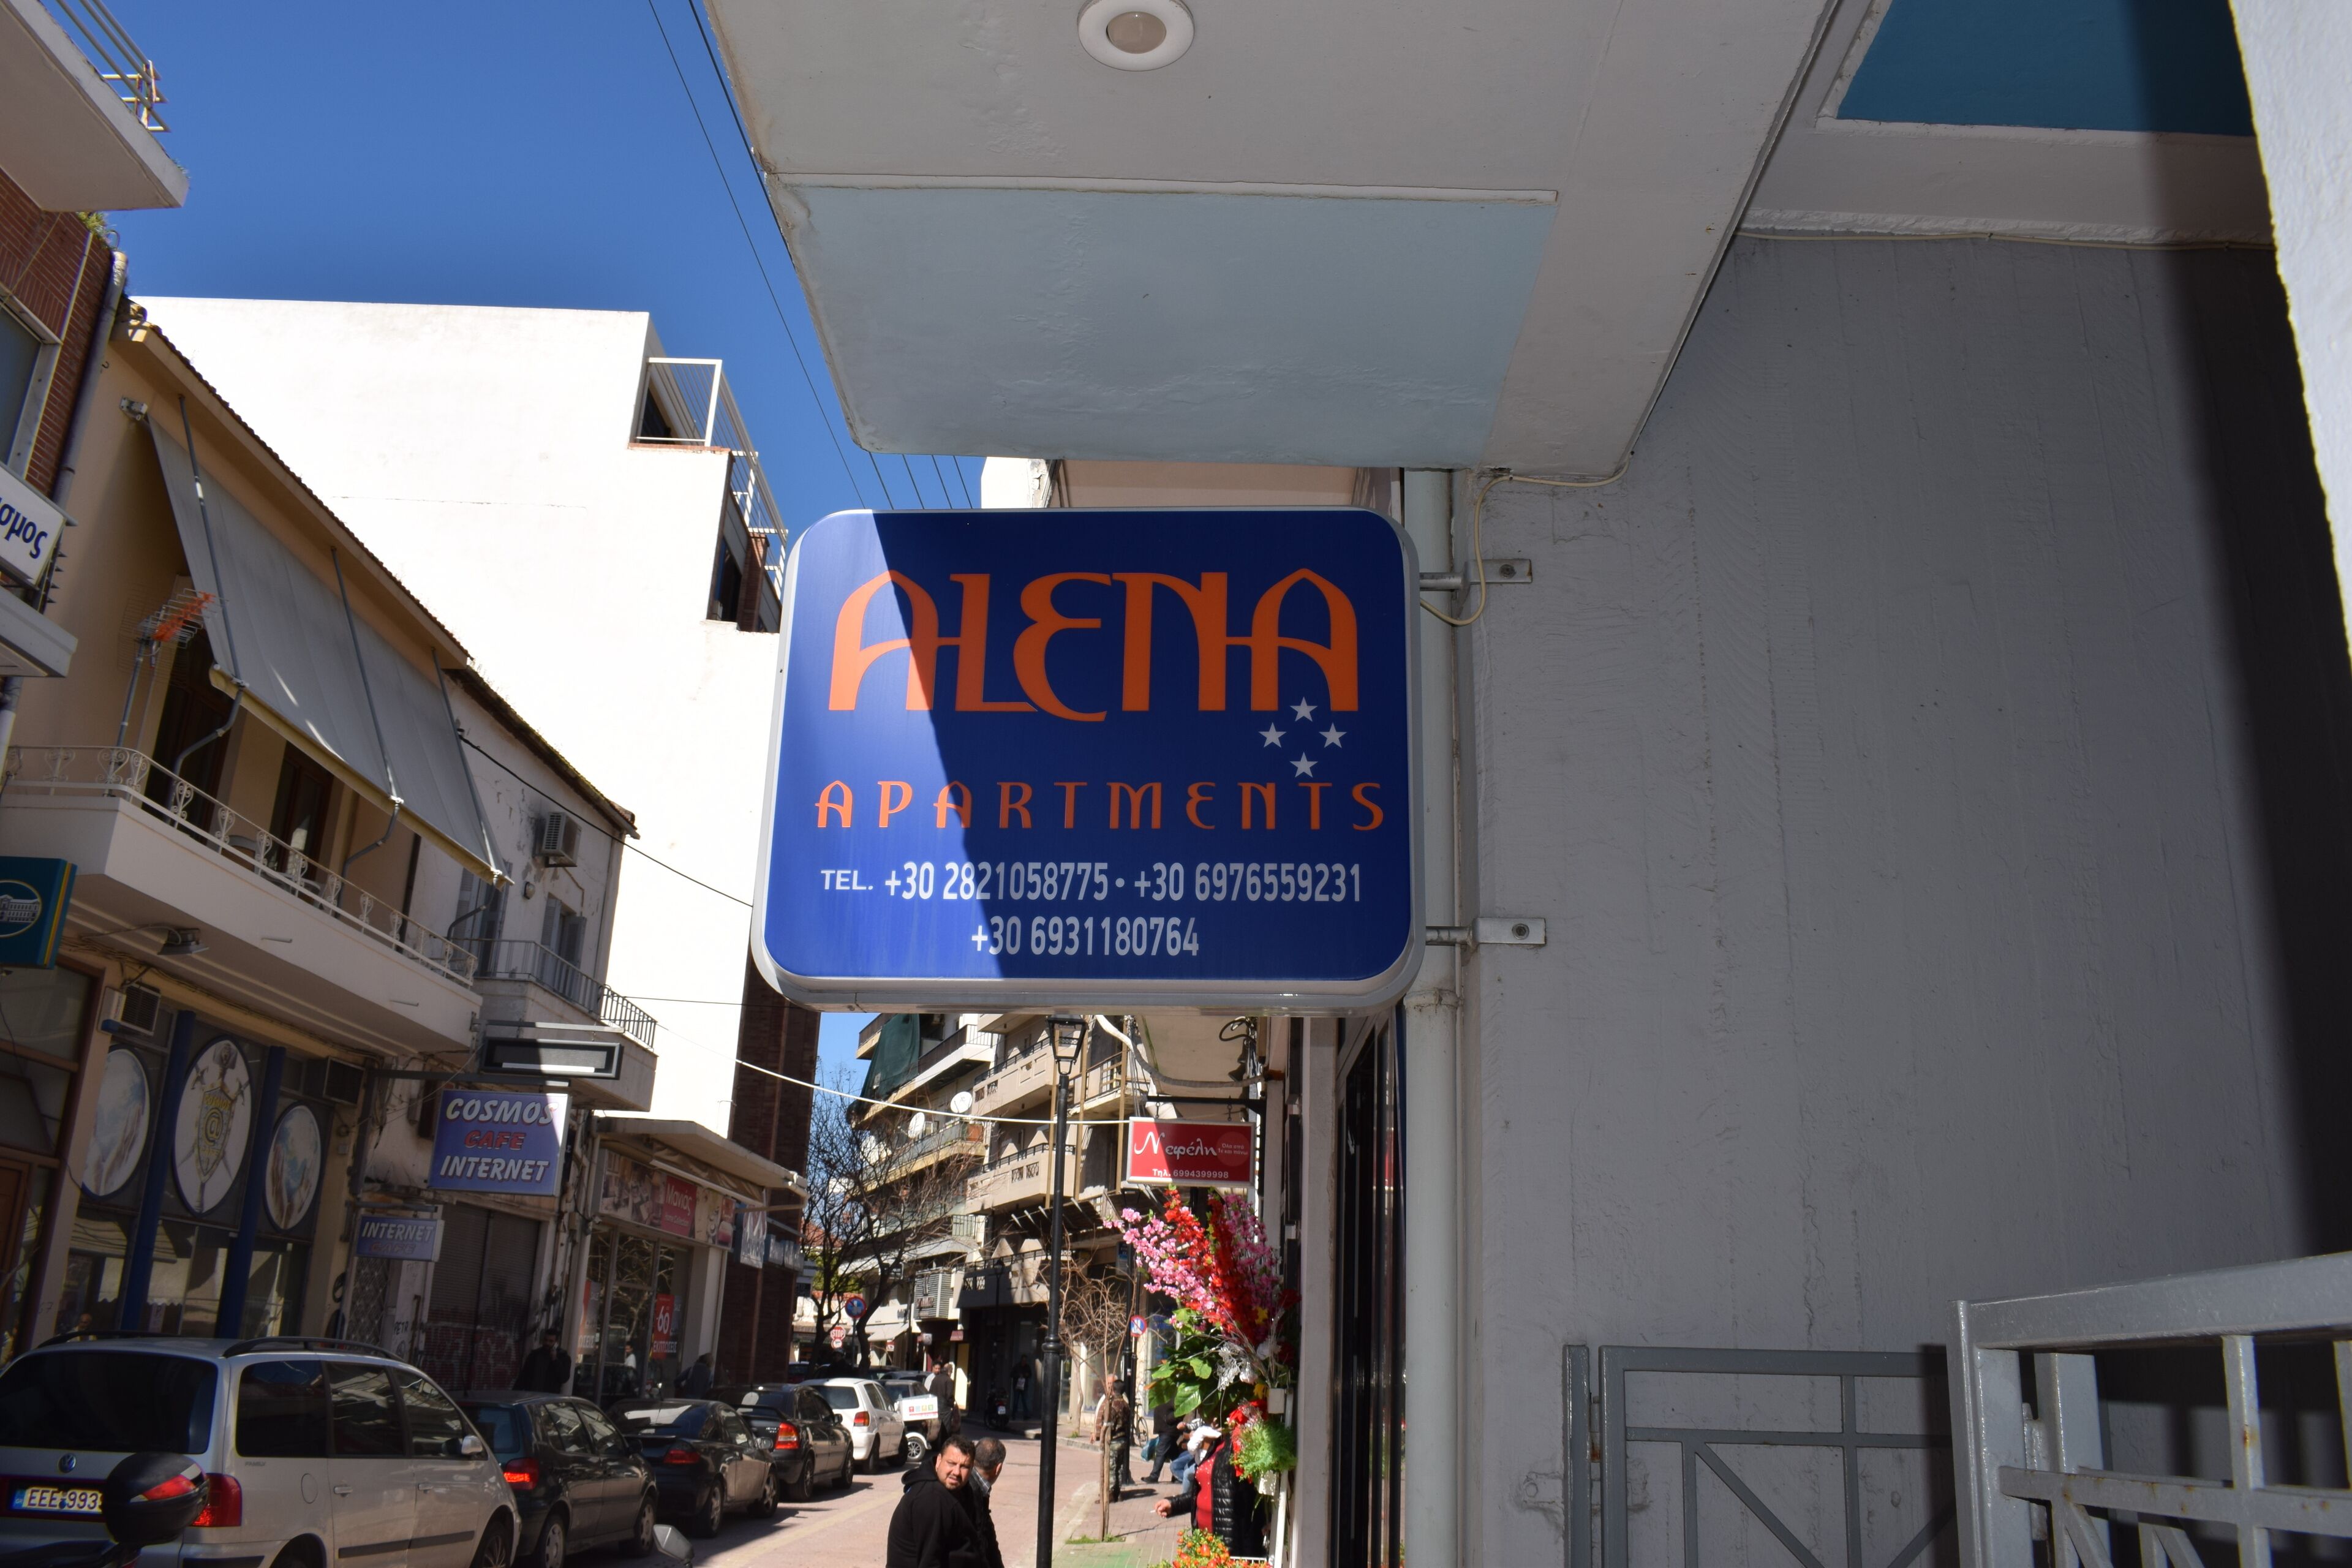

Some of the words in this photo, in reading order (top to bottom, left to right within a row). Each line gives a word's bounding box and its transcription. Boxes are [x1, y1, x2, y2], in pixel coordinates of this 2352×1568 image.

[0, 497, 48, 559] σμος
[828, 568, 1359, 723] ALENA
[815, 780, 1384, 832] APARTMENTS
[821, 869, 873, 891] TEL.
[884, 861, 935, 900] +30
[943, 861, 1109, 902] 2821058775
[1134, 862, 1185, 902] +30
[1195, 862, 1361, 902] 6976559231
[971, 916, 1021, 956] +30
[1030, 916, 1199, 957] 6931180764
[446, 1098, 559, 1125] COSMOS
[464, 1130, 527, 1150] CAFE
[1134, 1131, 1218, 1160] Νεφέλη
[439, 1155, 549, 1182] INTERNET
[1152, 1169, 1171, 1178] Τηλ.
[1173, 1169, 1229, 1179] 6994399998
[666, 1183, 693, 1216] Μανιάς
[361, 1221, 433, 1242] INTERNET
[371, 1242, 417, 1255] CAFE
[578, 1335, 595, 1348] ΩΣΕΙΣ
